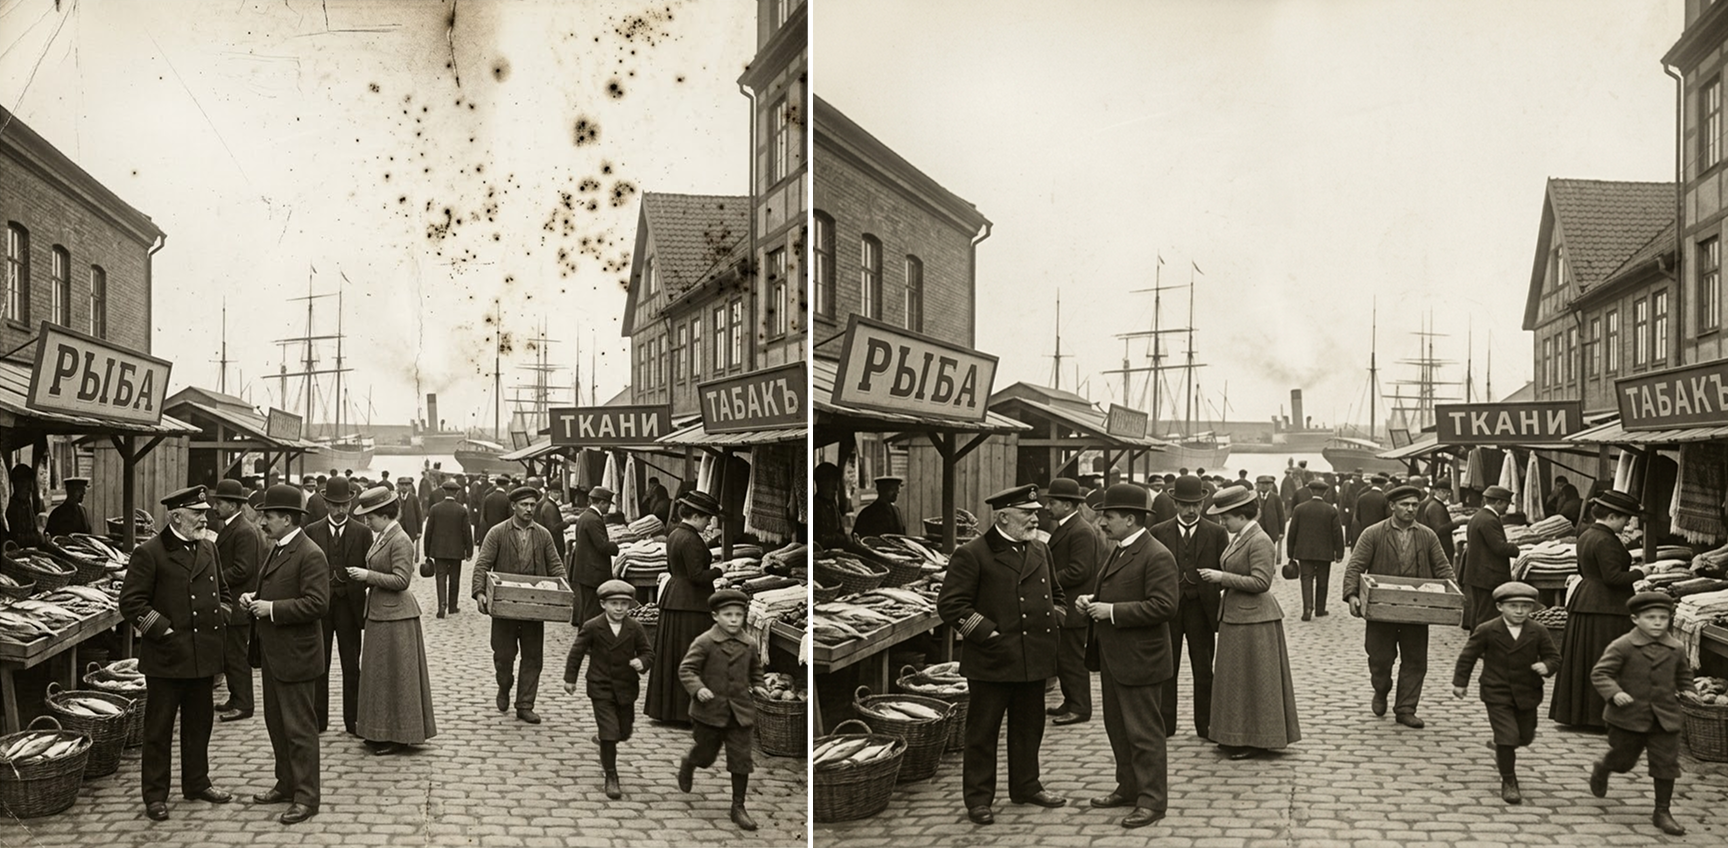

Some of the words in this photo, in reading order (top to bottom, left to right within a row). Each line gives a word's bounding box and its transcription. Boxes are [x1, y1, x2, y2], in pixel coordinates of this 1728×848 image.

[49, 343, 153, 412] РЫБА
[857, 336, 976, 408] РЫБА
[706, 378, 799, 423] ТАБАКЪ
[1625, 373, 1728, 420] ТАБАКЪ
[560, 412, 659, 438] ТКАНИ
[1448, 409, 1567, 435] ТКАНИ
